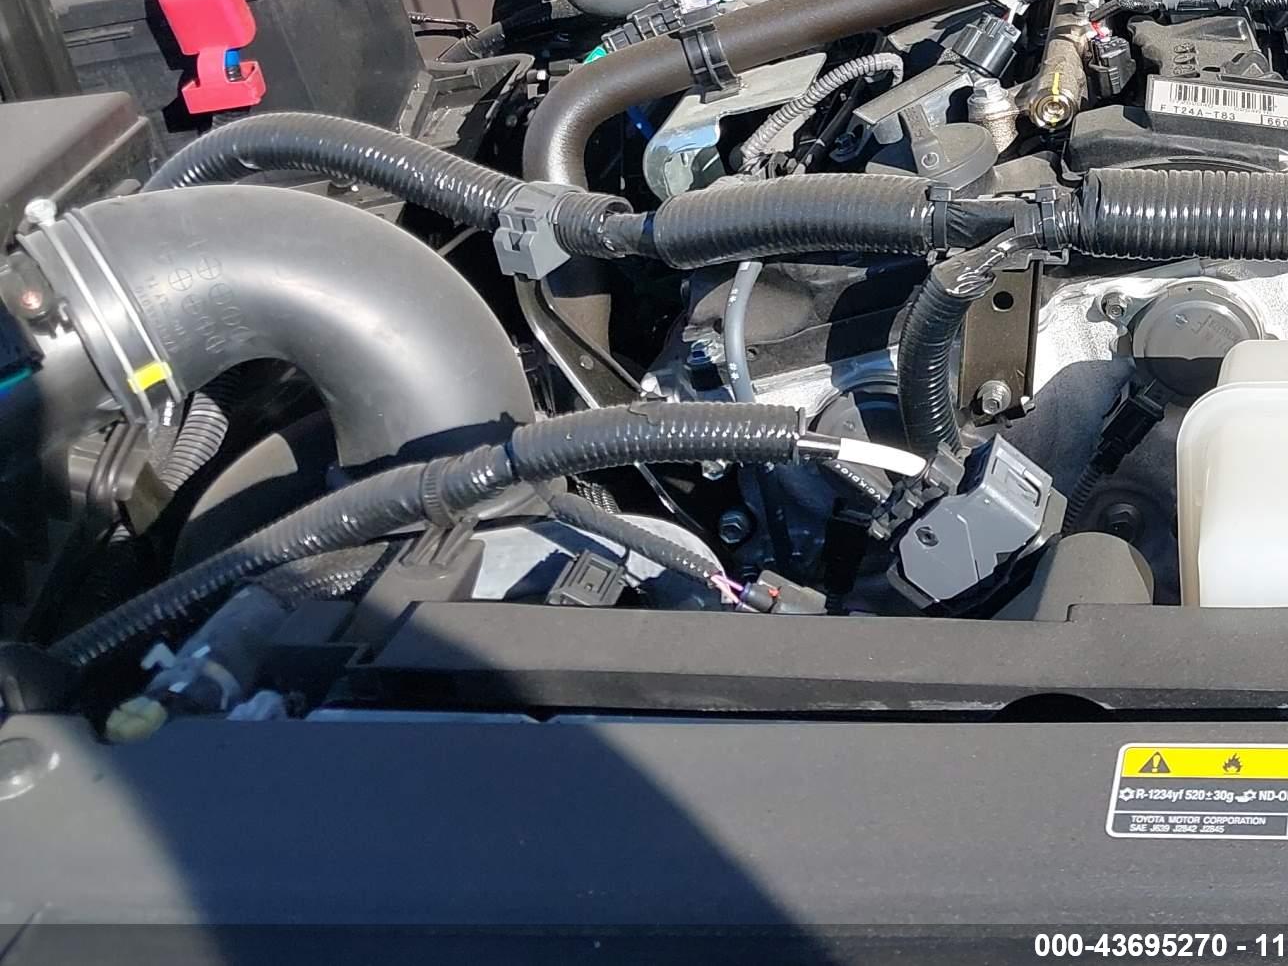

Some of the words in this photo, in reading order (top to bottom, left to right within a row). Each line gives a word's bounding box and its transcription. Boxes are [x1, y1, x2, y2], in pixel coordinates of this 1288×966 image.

[1173, 105, 1237, 121] T24A-T83
[1135, 788, 1184, 803] R-1234yf
[1130, 815, 1165, 824] TOYOTA
[1168, 816, 1200, 824] MOTOR
[1203, 816, 1266, 825] CORPORATION
[1129, 824, 1148, 832] SAE
